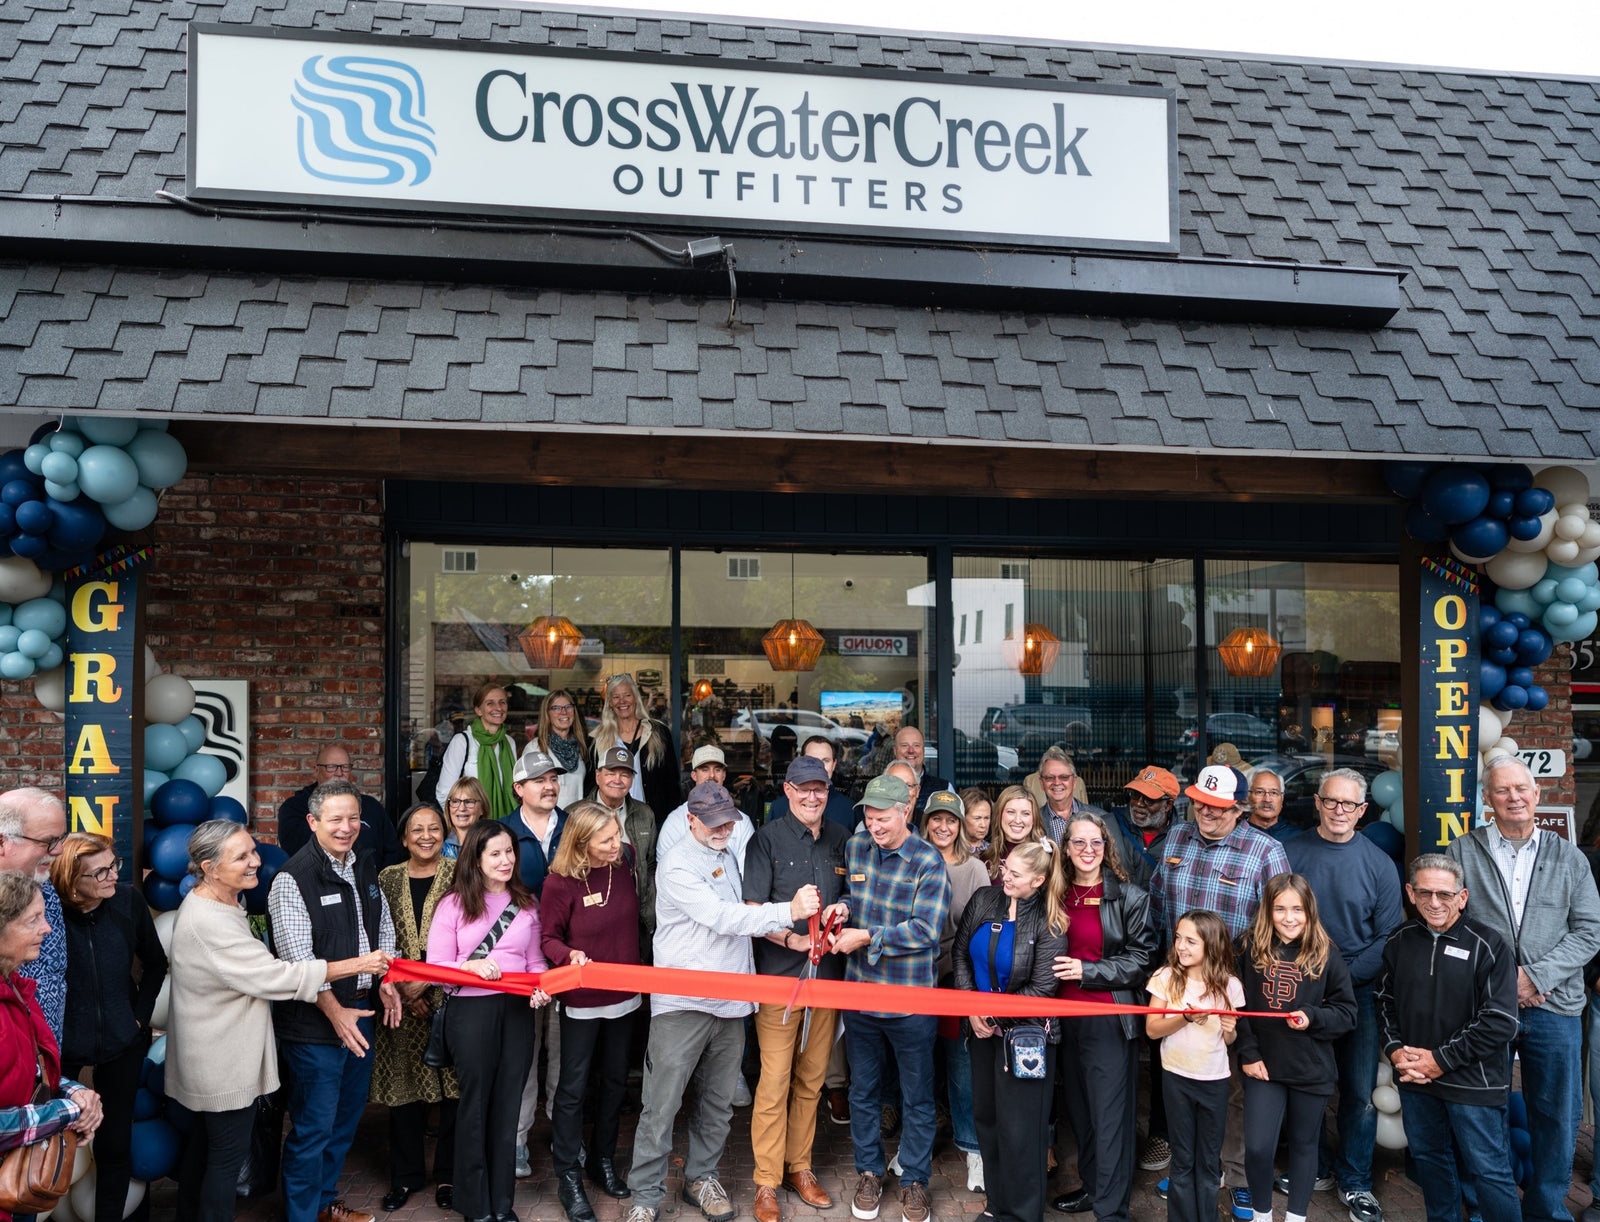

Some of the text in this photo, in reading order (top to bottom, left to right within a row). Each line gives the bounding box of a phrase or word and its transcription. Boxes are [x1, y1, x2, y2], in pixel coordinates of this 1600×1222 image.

[475, 69, 1092, 177] CrossWaterCreek
[613, 164, 963, 214] OUTFITTERS
[1515, 751, 1552, 774] 72
